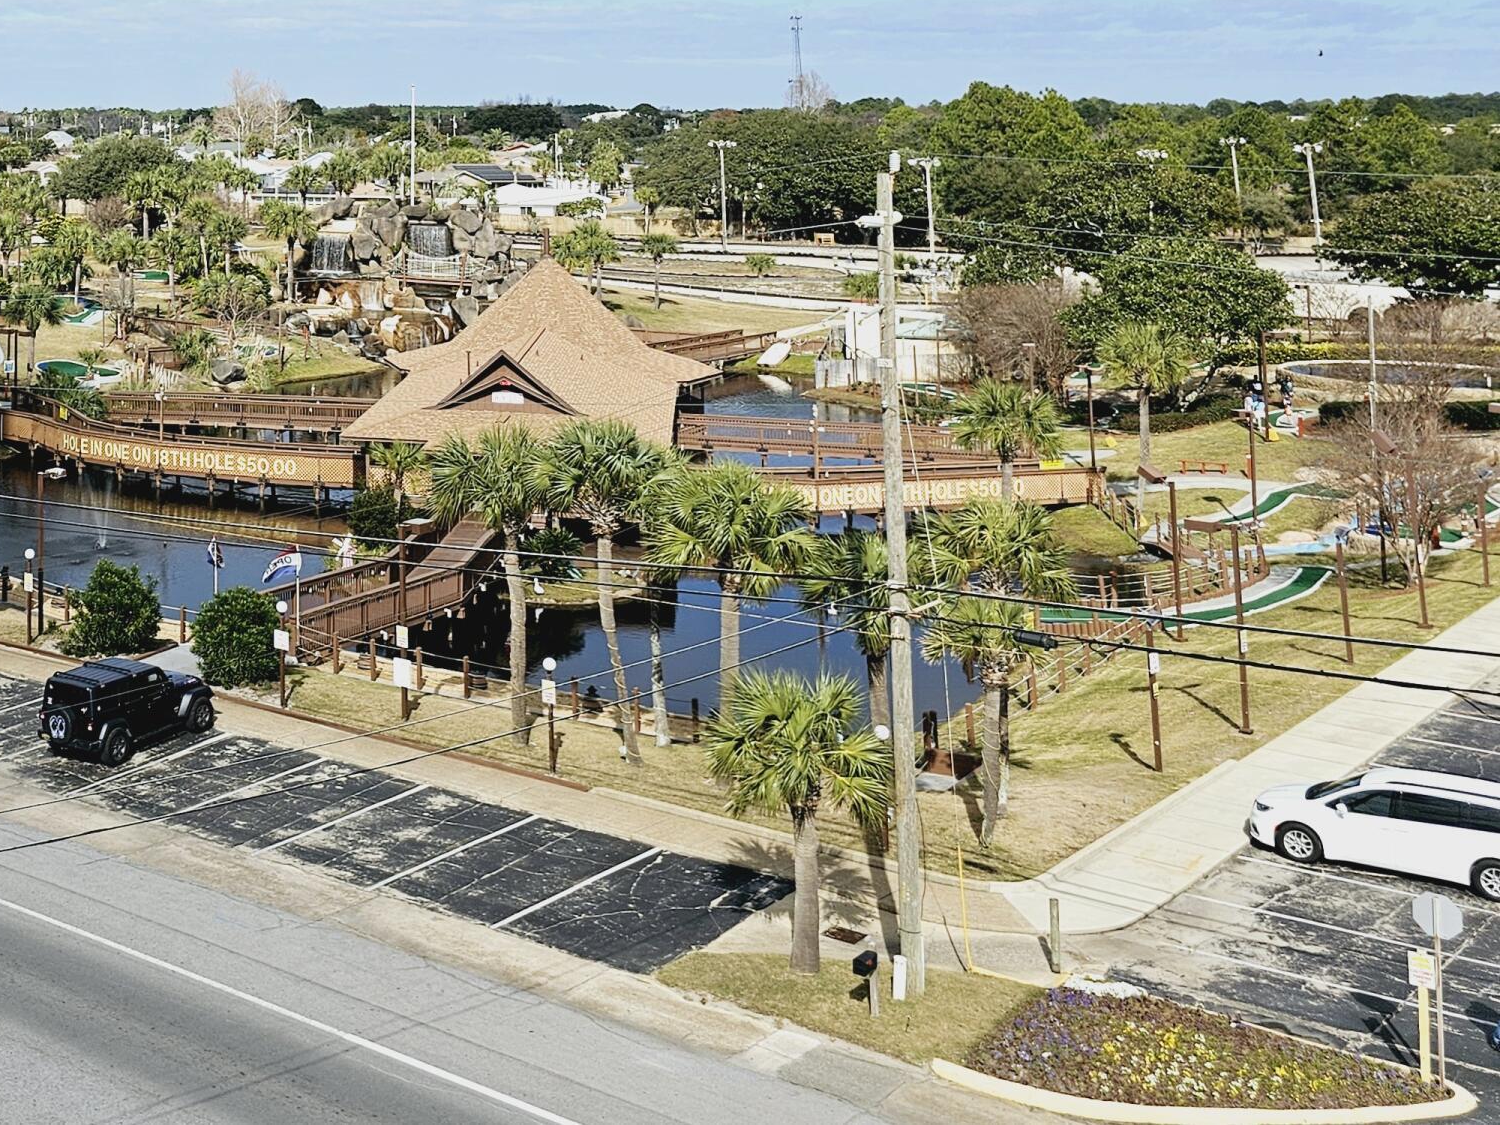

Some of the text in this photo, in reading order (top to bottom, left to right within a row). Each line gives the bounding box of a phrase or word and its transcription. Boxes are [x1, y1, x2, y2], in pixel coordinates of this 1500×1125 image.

[63, 434, 89, 454] HOLE
[90, 440, 102, 456] IN
[104, 442, 130, 460] ONE
[133, 446, 151, 463] ON
[154, 449, 192, 468] 18TH
[193, 452, 235, 471] HOLE
[819, 486, 855, 505] ONE
[856, 484, 882, 503] ON
[925, 480, 968, 500] HOLE
